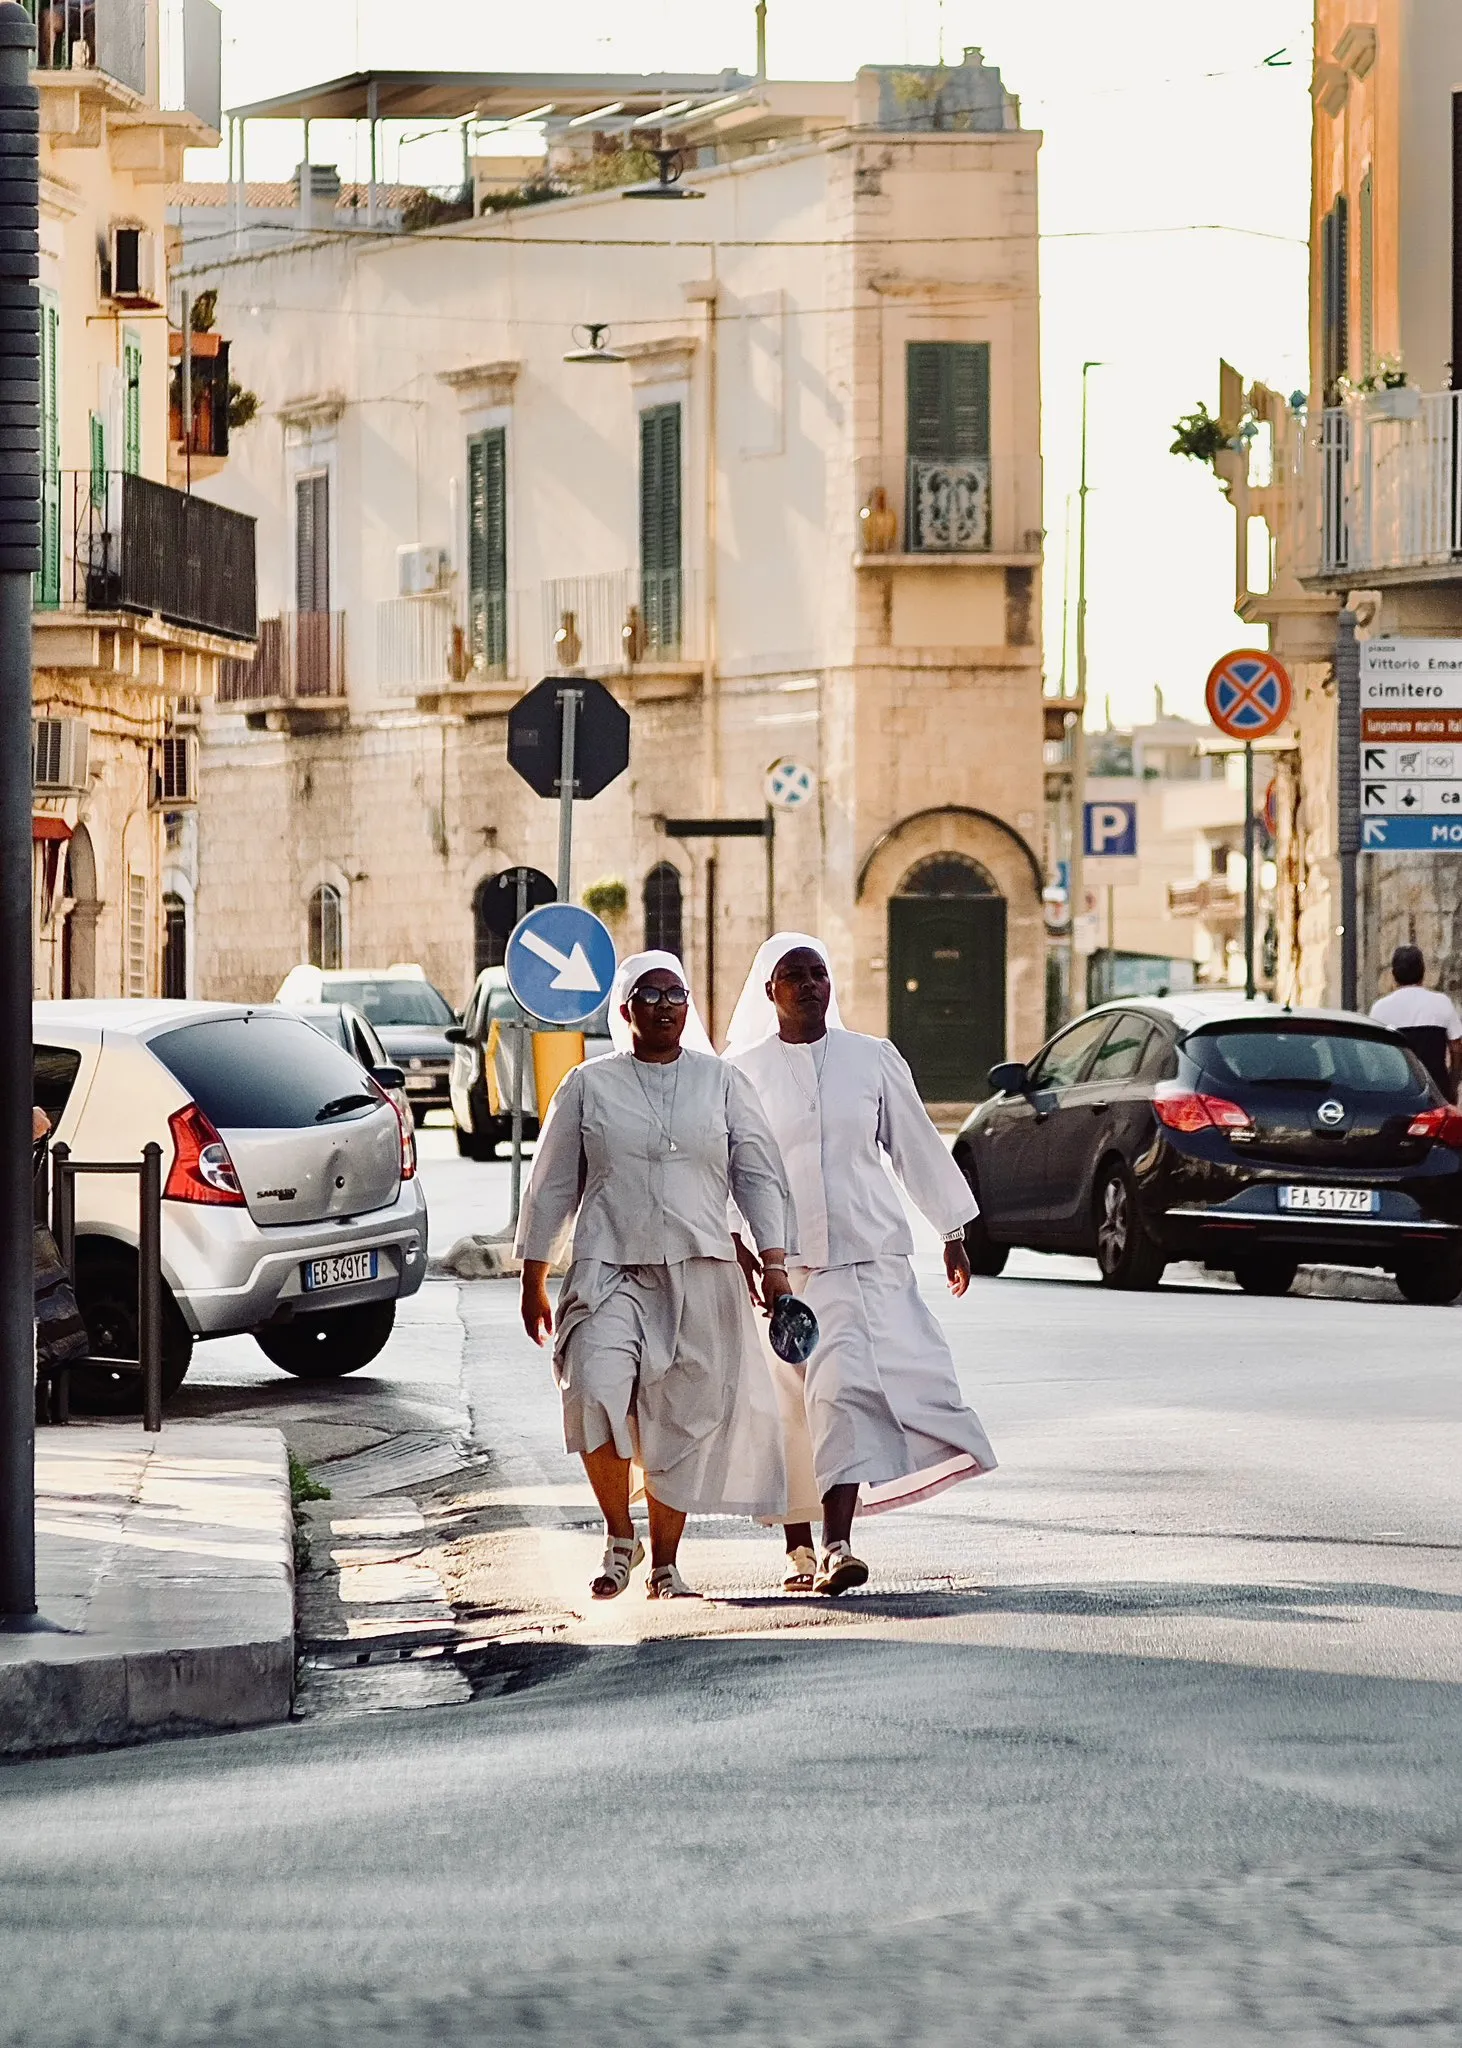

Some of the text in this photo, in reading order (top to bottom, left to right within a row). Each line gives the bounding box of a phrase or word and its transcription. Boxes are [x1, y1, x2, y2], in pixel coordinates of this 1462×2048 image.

[1368, 657, 1420, 669] Vittorio
[1368, 683, 1443, 697] cimitero
[1092, 806, 1128, 852] P
[1432, 825, 1462, 841] MO
[1291, 1188, 1368, 1209] FA 517ZP
[313, 1253, 369, 1285] EB 349YF
